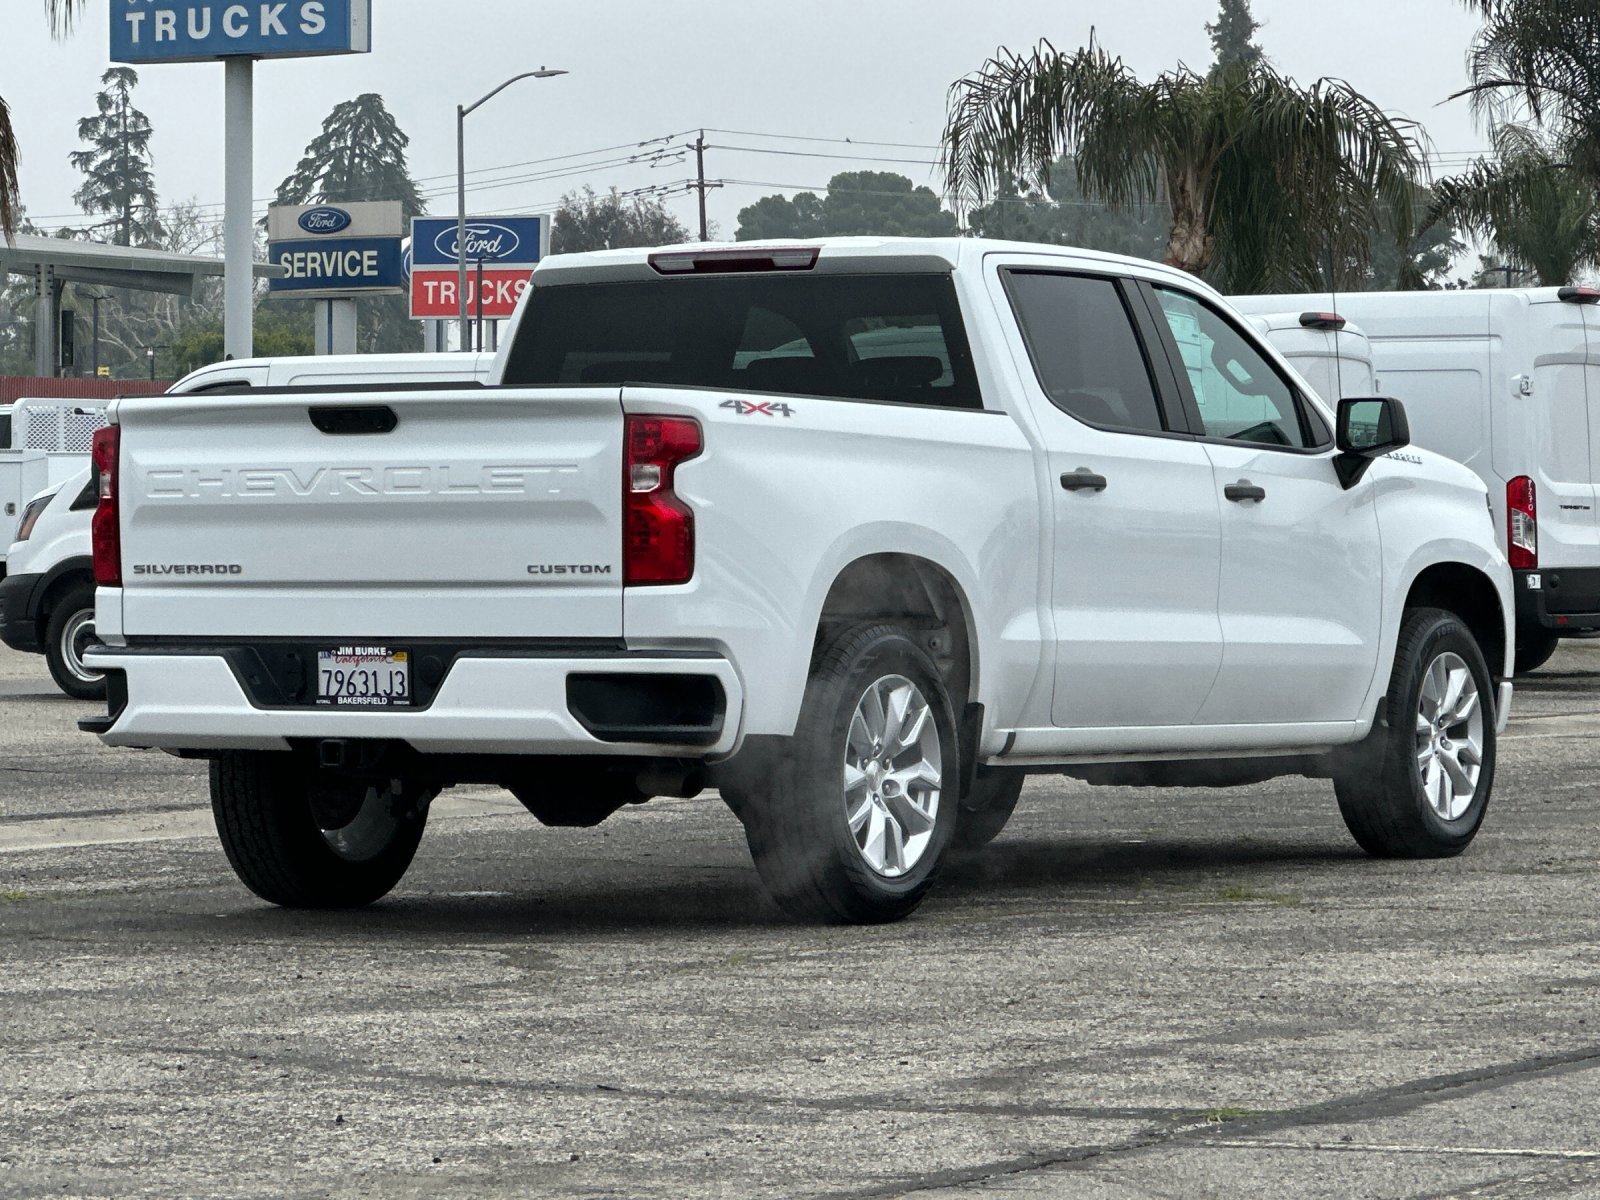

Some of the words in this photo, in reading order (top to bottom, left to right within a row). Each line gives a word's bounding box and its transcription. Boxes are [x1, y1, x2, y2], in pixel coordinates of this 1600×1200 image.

[126, 1, 326, 43] TRUCKS
[308, 213, 337, 228] Ford
[451, 228, 503, 254] Ford
[280, 250, 379, 279] SERVICE
[146, 464, 578, 498] CHEVROLET
[133, 564, 242, 575] SILVERADO
[526, 564, 612, 574] CUSTOM
[337, 647, 352, 656] JIM
[354, 647, 387, 656] BURKE
[321, 669, 405, 697] 79631J3
[337, 696, 388, 705] BAKERSFIELD
